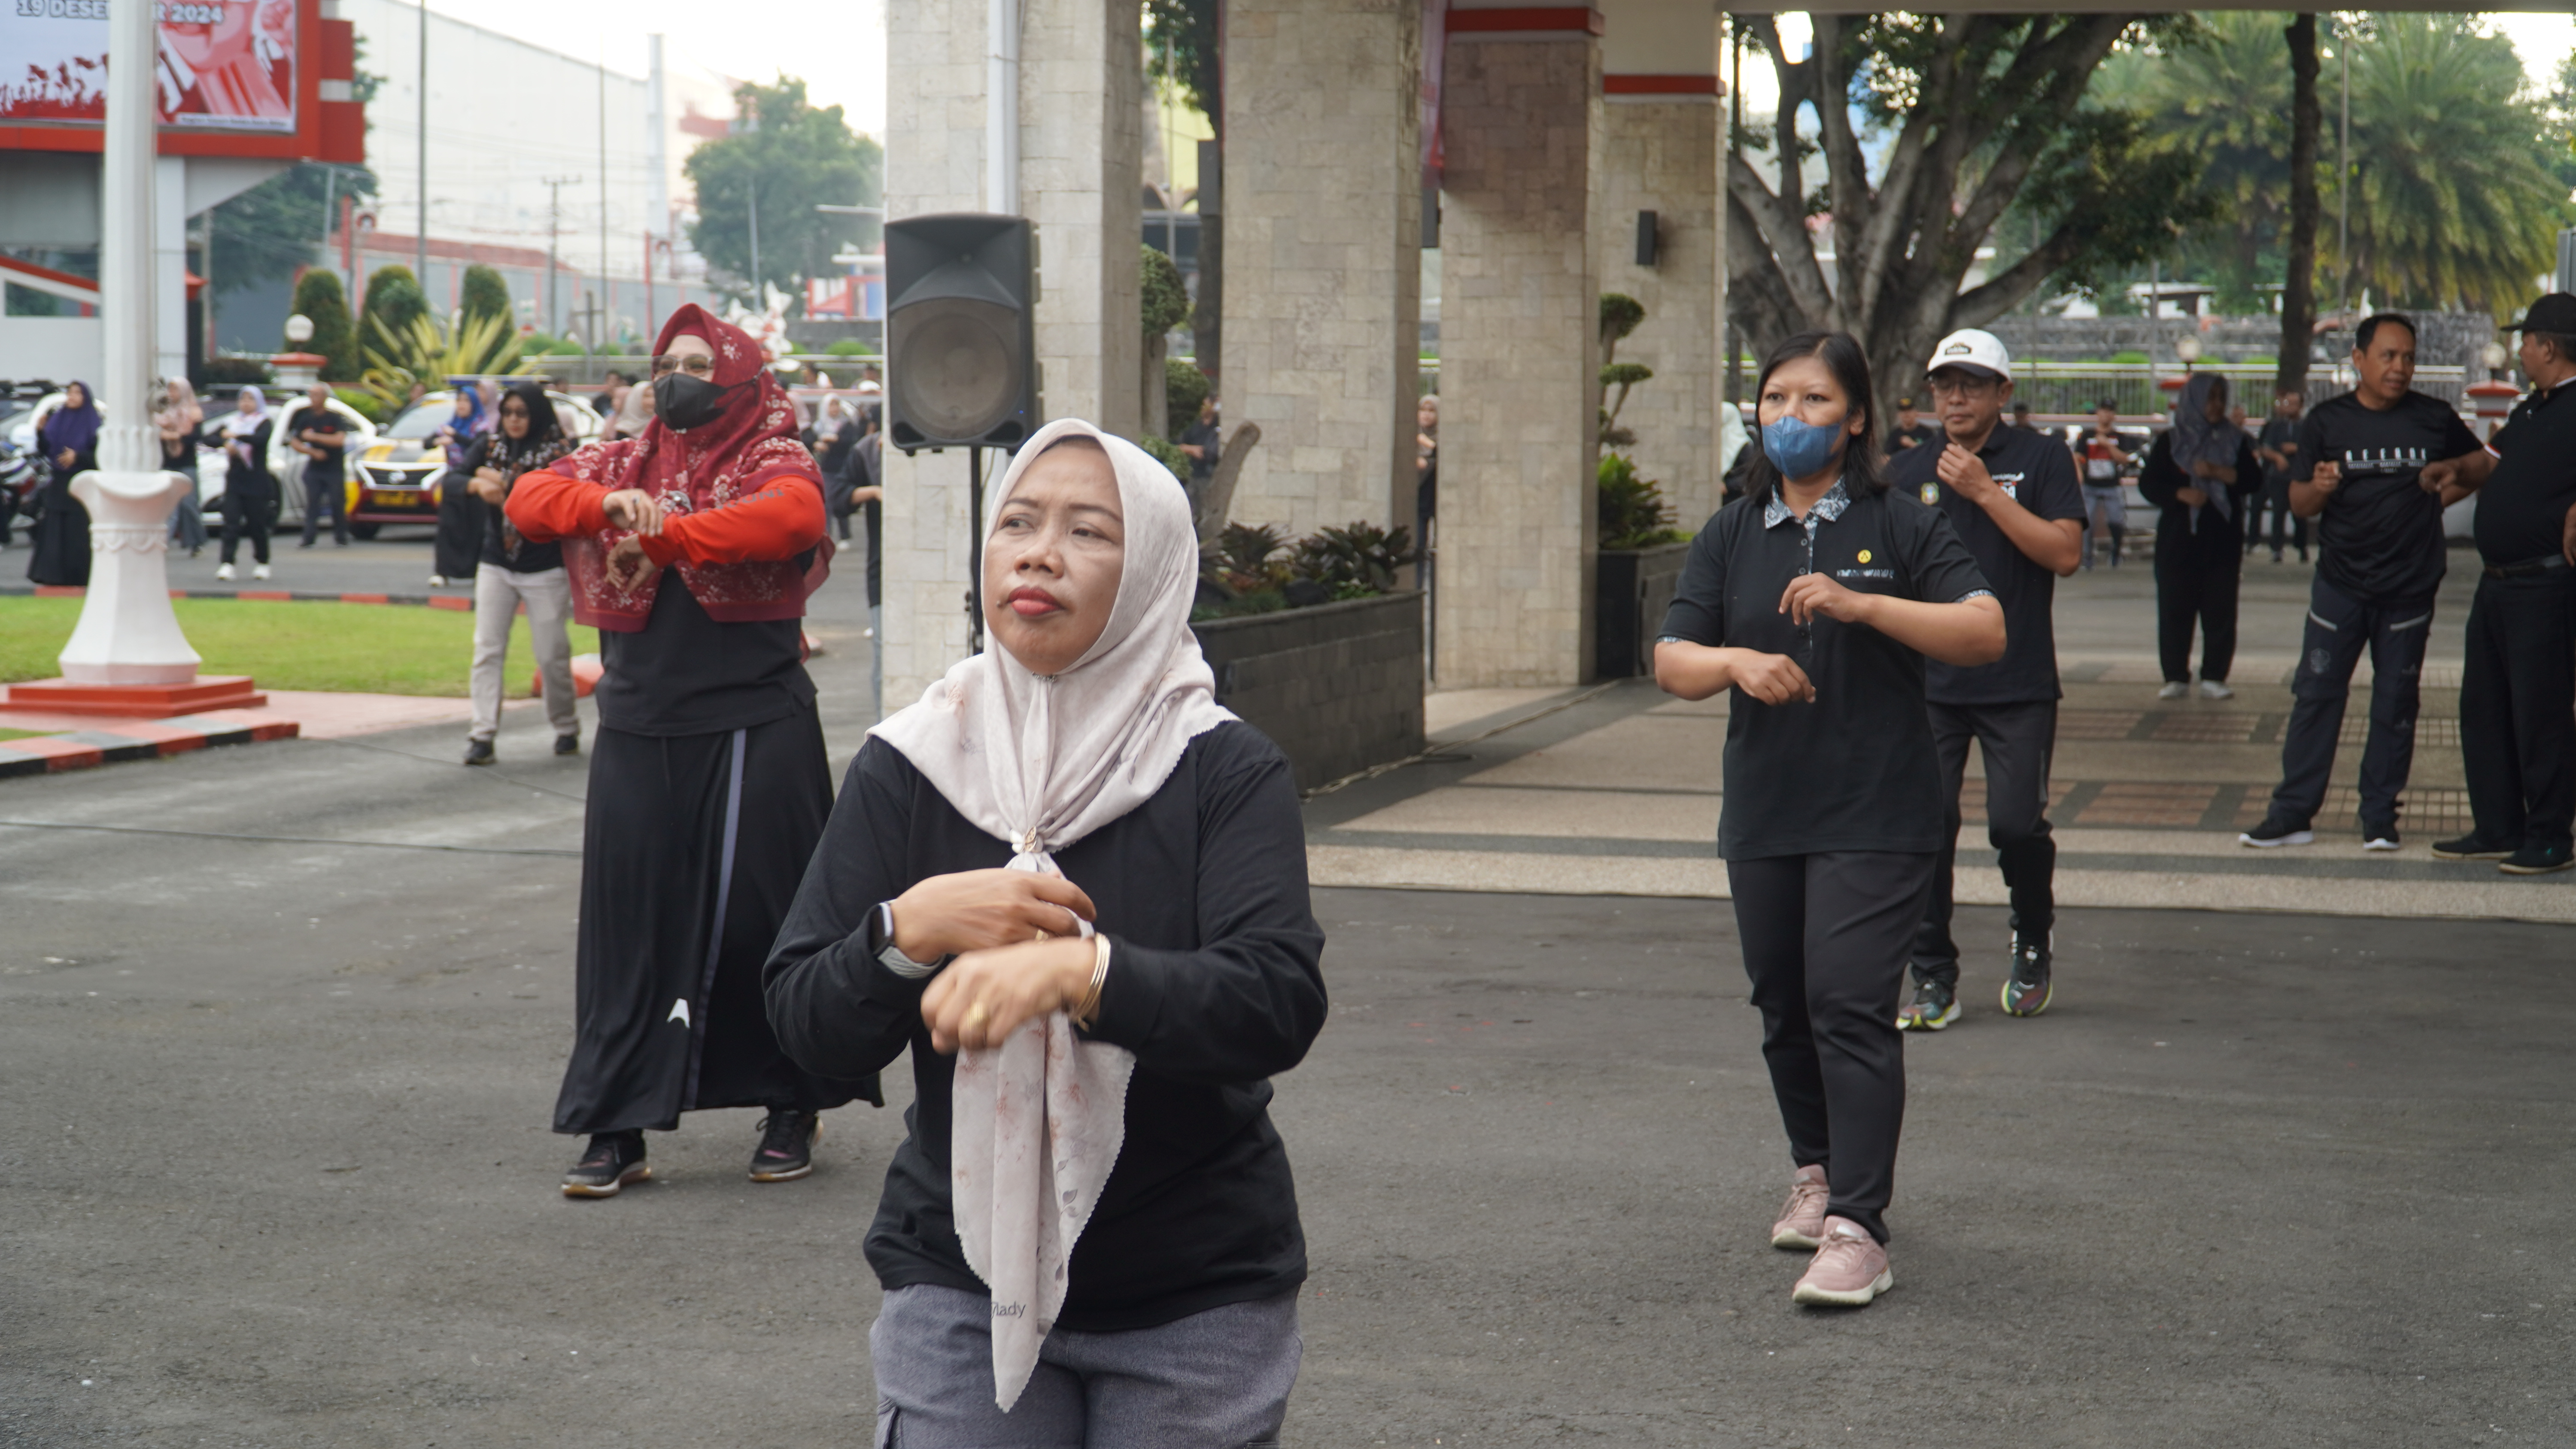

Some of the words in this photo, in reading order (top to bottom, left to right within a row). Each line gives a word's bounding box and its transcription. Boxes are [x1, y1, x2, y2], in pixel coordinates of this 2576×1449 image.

[17, 0, 43, 16] 19
[49, 0, 167, 22] DESER
[172, 3, 224, 24] 2024
